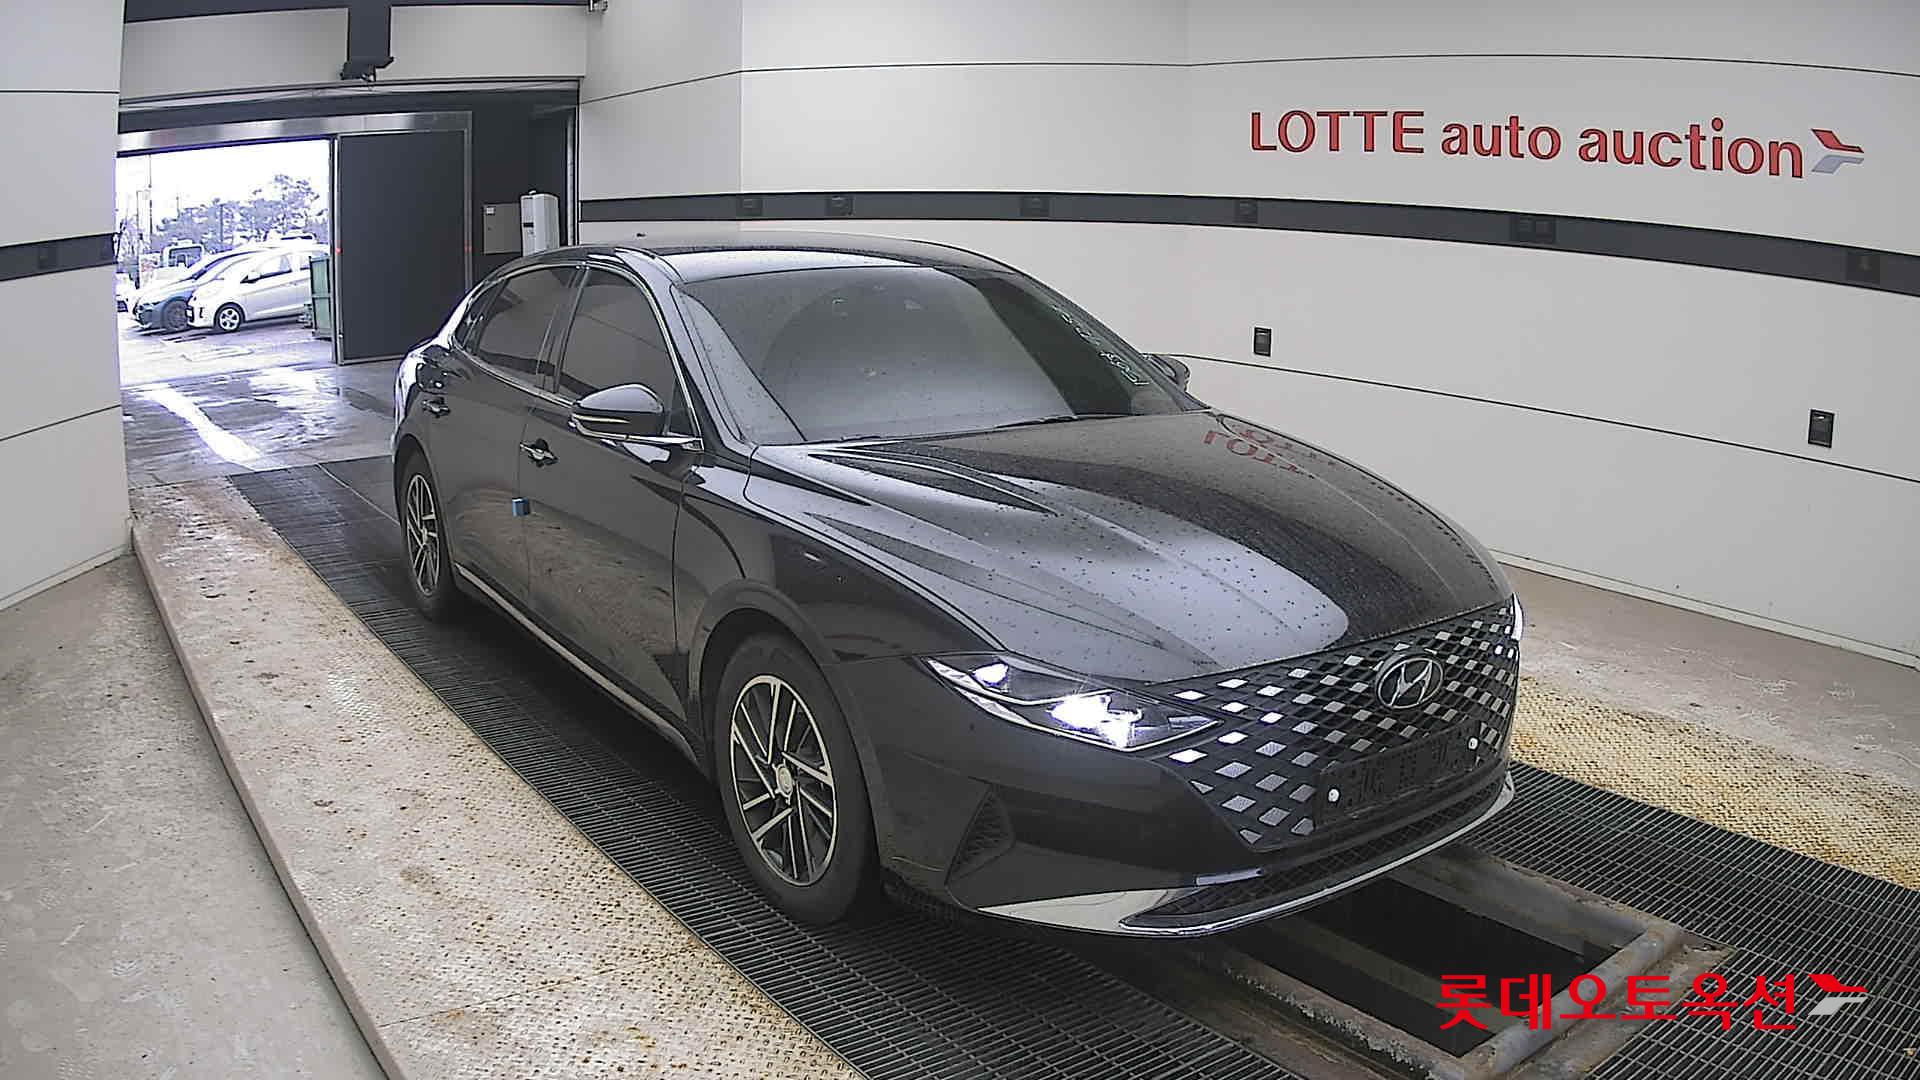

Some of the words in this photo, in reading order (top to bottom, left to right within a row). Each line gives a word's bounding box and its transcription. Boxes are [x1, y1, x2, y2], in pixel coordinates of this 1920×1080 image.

[1251, 110, 1425, 154] LOTTE
[1441, 115, 1562, 160] auto
[1578, 117, 1804, 179] auction
